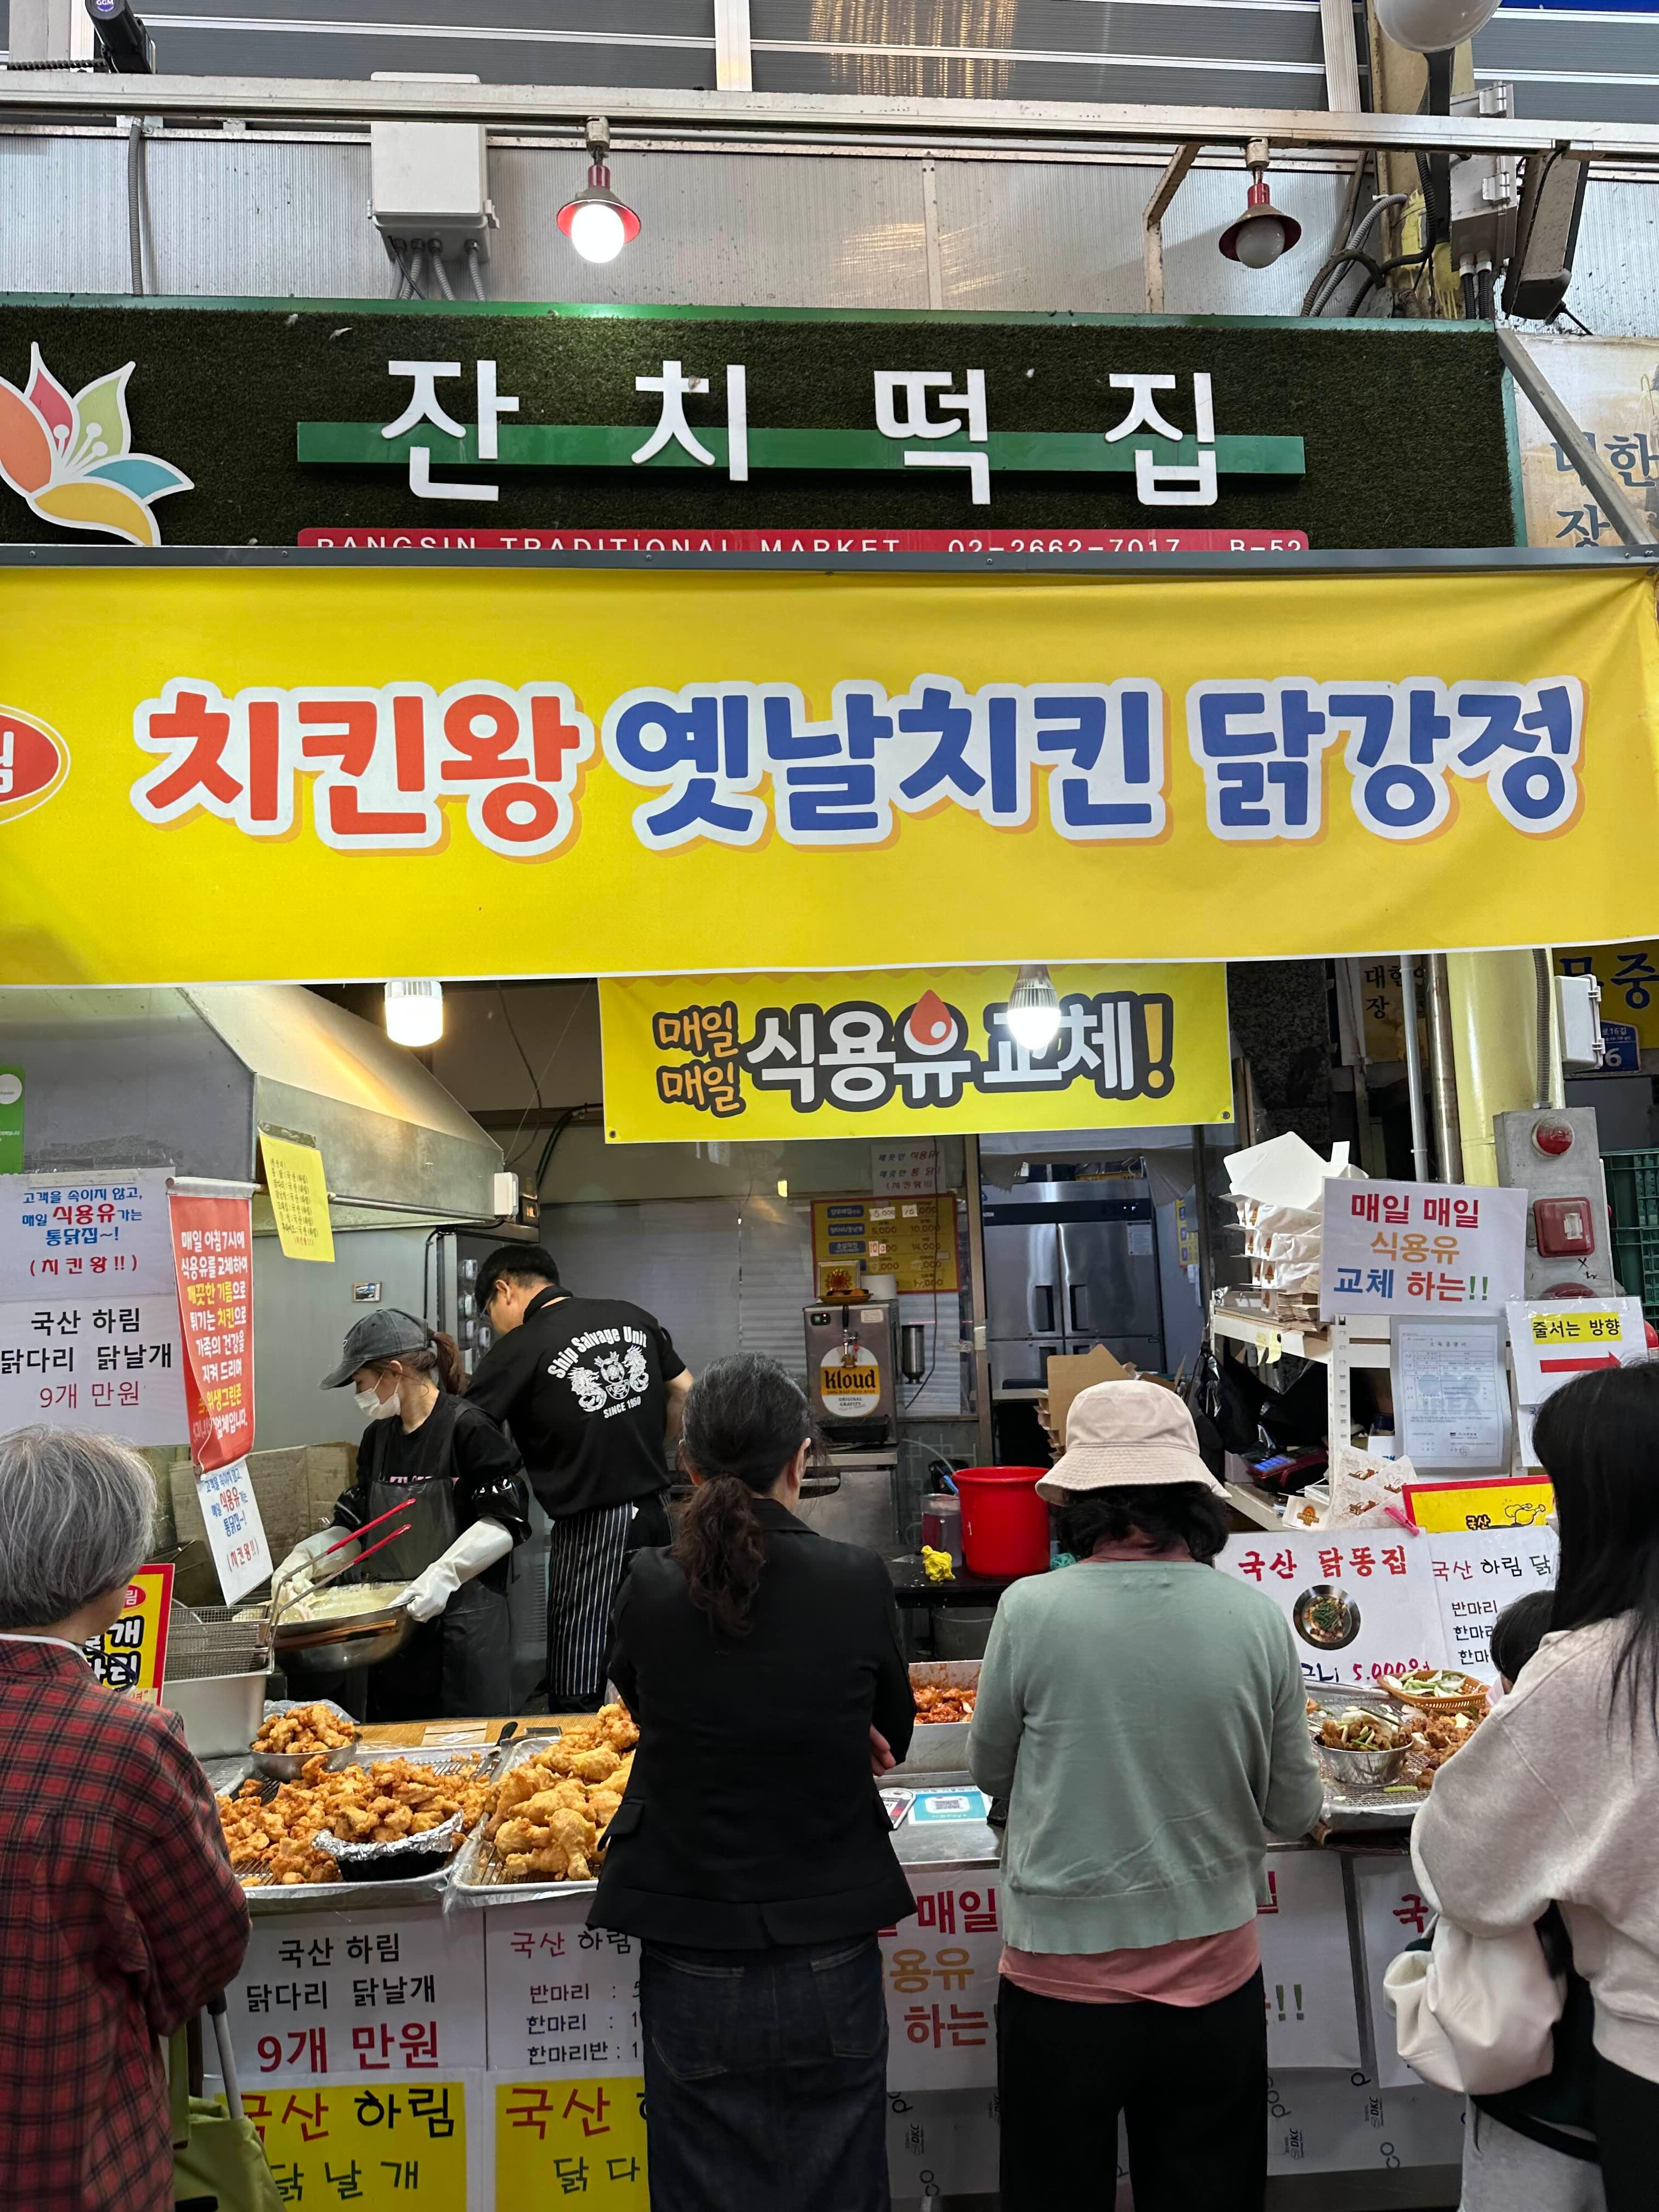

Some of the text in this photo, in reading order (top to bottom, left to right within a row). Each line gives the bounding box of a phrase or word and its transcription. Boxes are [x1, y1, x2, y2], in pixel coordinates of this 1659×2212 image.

[145, 690, 582, 843] 치킨왕
[614, 687, 1152, 837] 옛날치킨
[1199, 685, 1571, 827] 닭강정
[659, 1006, 735, 1056] 매일
[747, 1008, 971, 1103] 식용유
[661, 1062, 737, 1110] 매일
[22, 1187, 143, 1204] 고객을 속이지 않고,
[22, 1213, 48, 1227] 매일
[1351, 1193, 1479, 1229] 매일 매일
[181, 1229, 202, 1252] 매일
[1370, 1231, 1460, 1265] 식용유
[181, 1255, 216, 1281] 식용유를
[187, 1280, 246, 1306] 깨끗한 기름으로
[1334, 1267, 1489, 1302] 교체 하는!!
[31, 1307, 140, 1336] 국산 하림
[190, 1306, 246, 1332] 튀기는 치킨으로
[1532, 1318, 1620, 1339] 줄서는 방향
[1, 1342, 172, 1374] 닭다리 닭날개
[195, 1329, 245, 1359] 가족의 건강을
[547, 1325, 647, 1379] Ship Salvage Unit
[201, 1363, 219, 1384] 지켜
[824, 1369, 876, 1390] Kloud
[40, 1380, 139, 1409] 9개 만원
[603, 1402, 627, 1419] SINCE
[1238, 1545, 1407, 1582] 국산 닭똥집
[1431, 1560, 1474, 1582] 국산
[1480, 1556, 1523, 1578] 하림
[1451, 1600, 1498, 1617] 반마리
[917, 1888, 998, 1934] 매일
[278, 1932, 399, 1968] 국산 하림
[510, 1931, 631, 1959] 국산 하림
[246, 1974, 436, 2013] 닭다리 닭날개
[529, 1983, 589, 2004] 반마리
[527, 2013, 586, 2035] 한마리
[904, 2003, 989, 2049] 하는
[257, 2021, 439, 2073] 9개 만원
[527, 2041, 608, 2066] 한마리반
[354, 2088, 455, 2138] 하림
[506, 2086, 611, 2140] 국산
[1369, 2095, 1380, 2117] DKC
[910, 2124, 920, 2143] DKC
[1289, 2128, 1300, 2148] DKC
